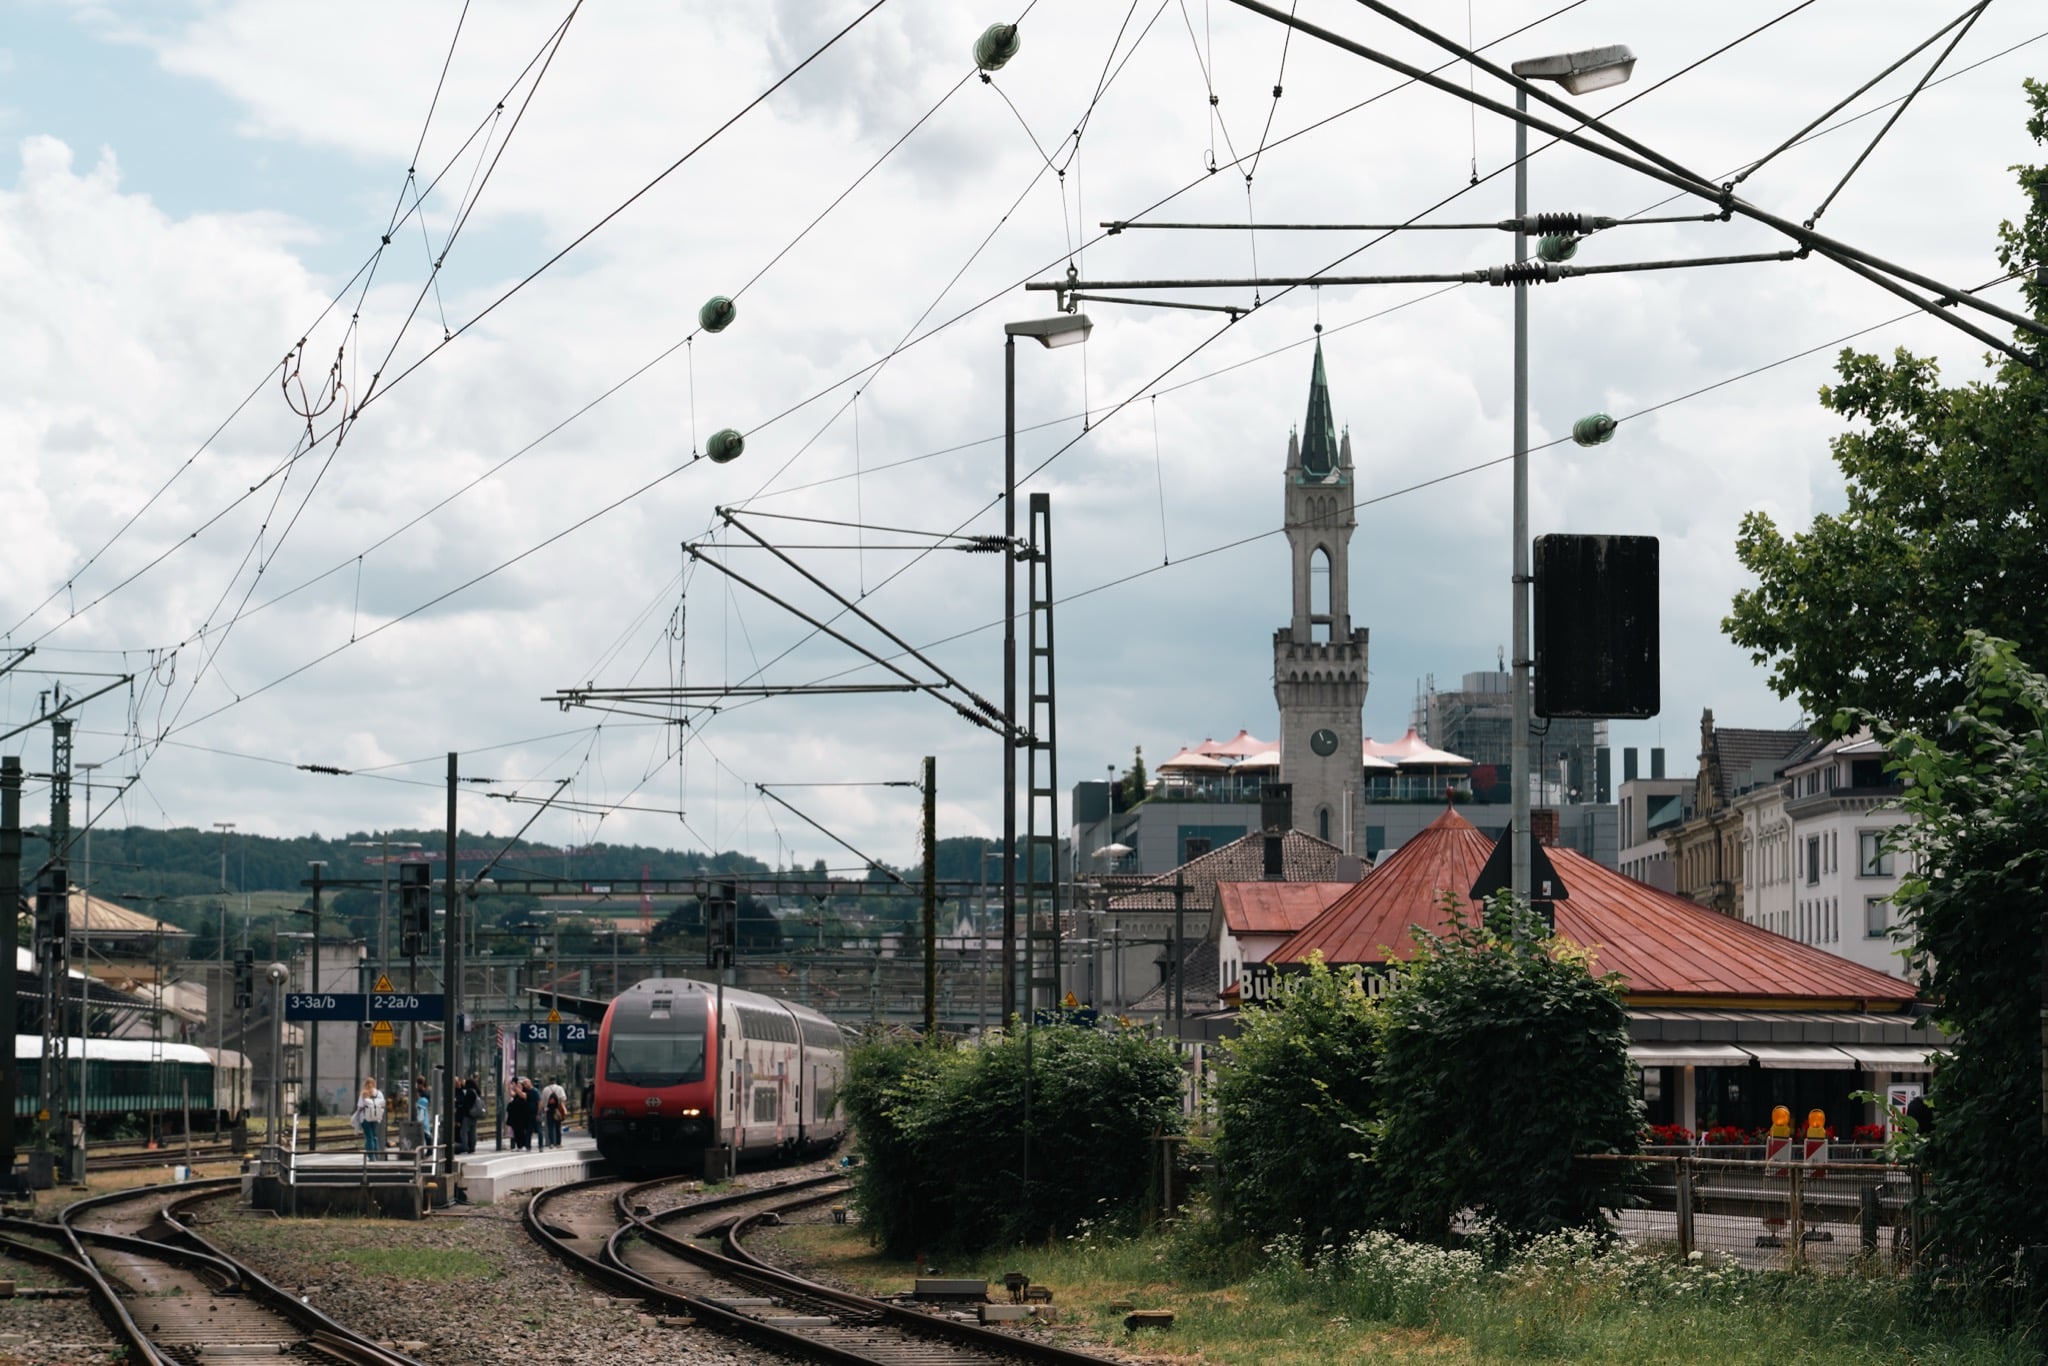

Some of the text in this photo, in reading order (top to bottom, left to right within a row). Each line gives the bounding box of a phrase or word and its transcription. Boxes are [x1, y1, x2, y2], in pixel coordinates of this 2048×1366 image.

[291, 995, 336, 1009] 3-3a/b
[374, 995, 419, 1009] 2-2a/b
[528, 1024, 548, 1039] 3a
[566, 1025, 586, 1039] 2a
